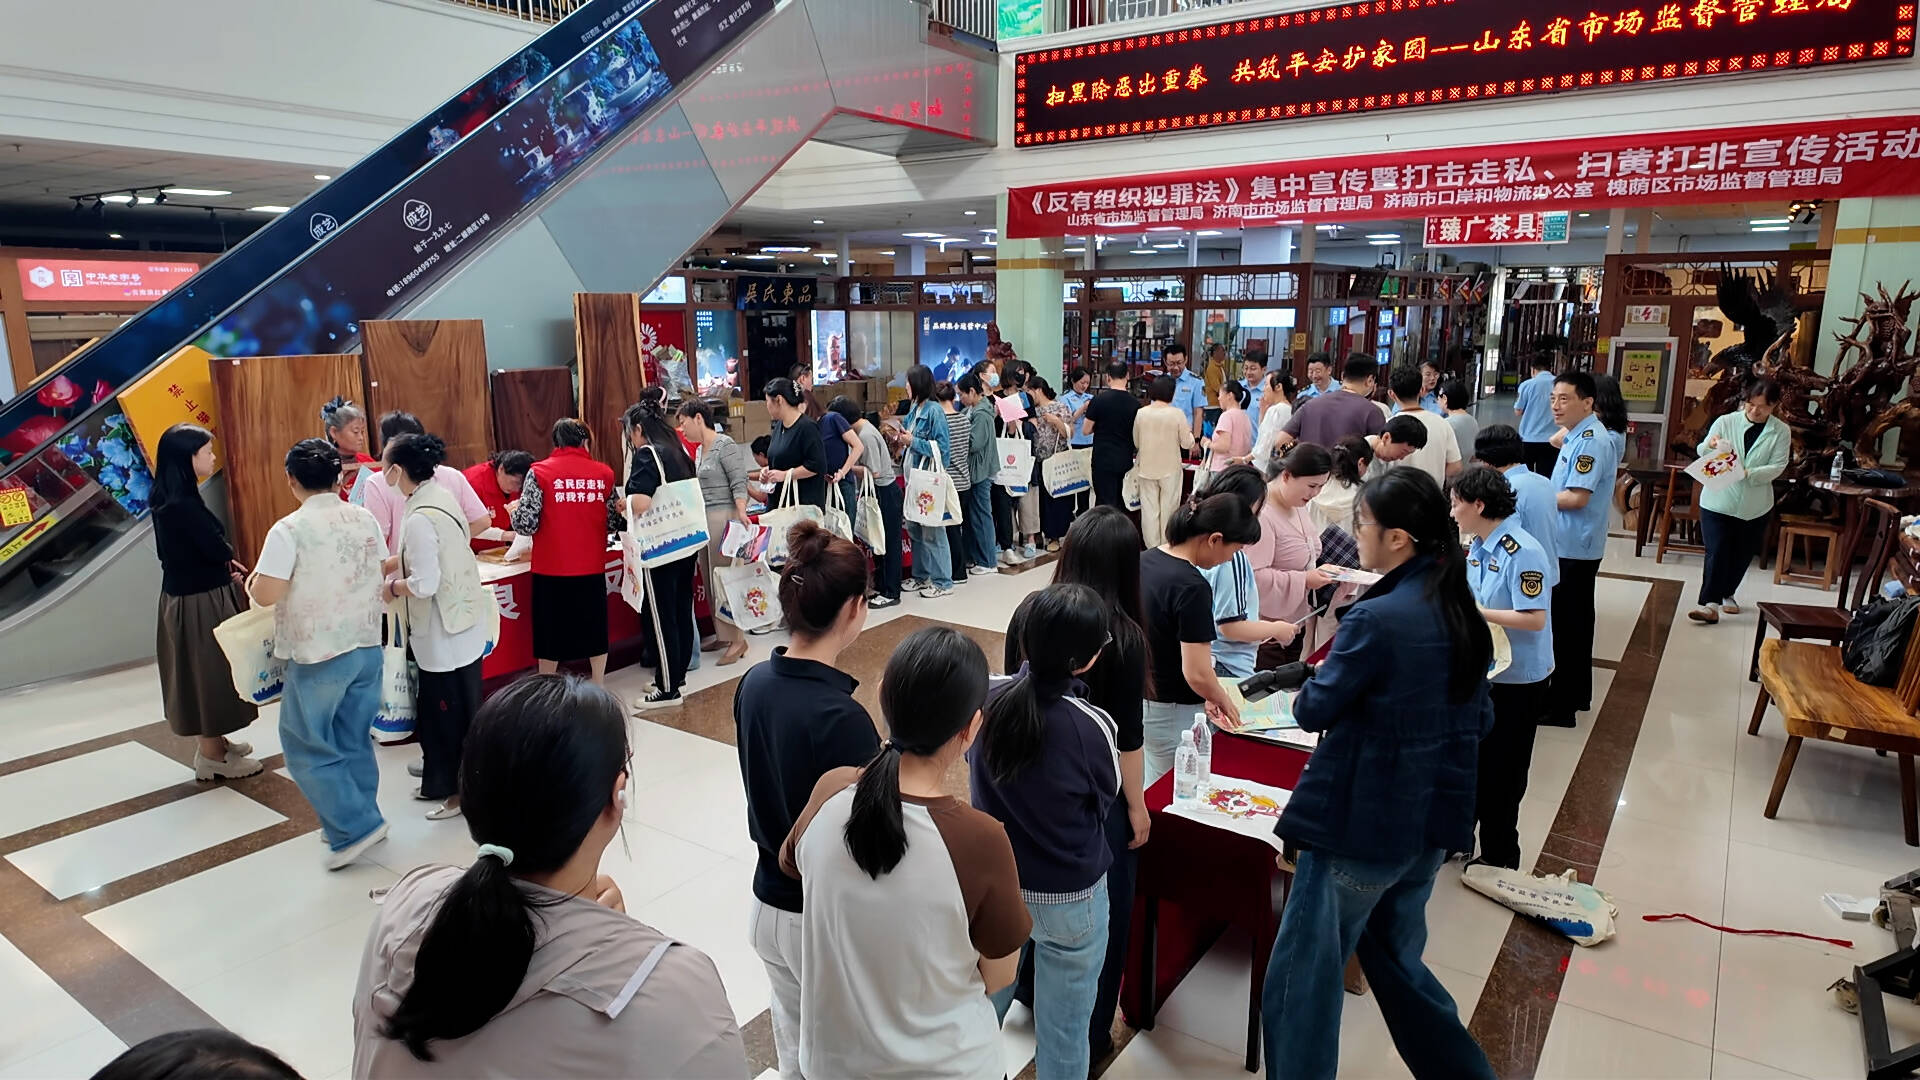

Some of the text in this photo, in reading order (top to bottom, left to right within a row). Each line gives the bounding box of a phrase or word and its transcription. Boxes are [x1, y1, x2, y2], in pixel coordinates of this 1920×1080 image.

[1045, 64, 1208, 107] 扫黑除恶出重拳
[1067, 166, 1843, 227] 山东省市场监督管理局 济南市市场监督管理局 济南市口岸和物流办公室 槐荫区市场监督管理局
[313, 216, 336, 240] 成艺
[406, 204, 429, 227] 成艺
[1439, 213, 1537, 242] 臻广茶具
[412, 221, 453, 255] 始于一九九七
[553, 478, 606, 490] 全民反走私
[554, 491, 605, 503] 你我齐参与
